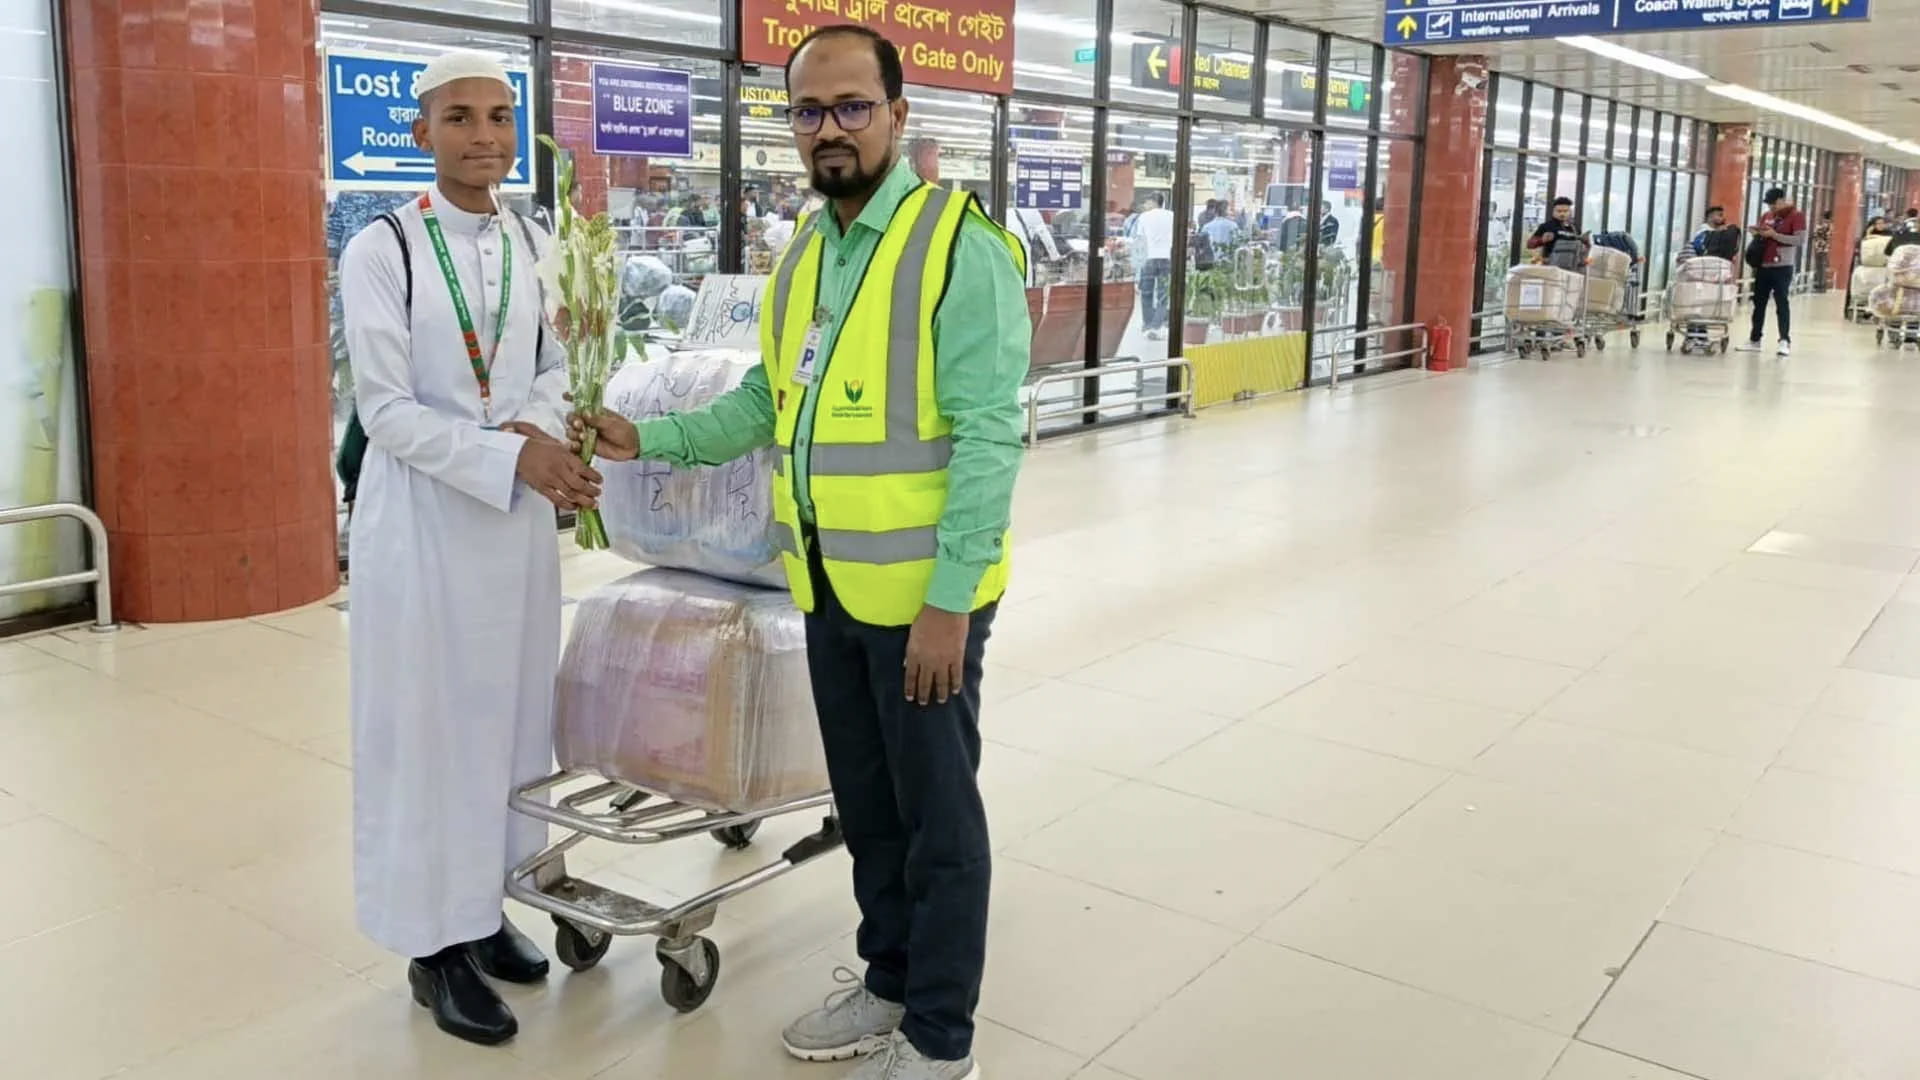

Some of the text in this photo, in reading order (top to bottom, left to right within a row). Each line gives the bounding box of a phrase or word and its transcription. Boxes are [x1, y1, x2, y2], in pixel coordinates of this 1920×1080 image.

[1461, 3, 1600, 23] International Arrivals
[1635, 0, 1678, 12] Coach
[895, 3, 951, 34] প্রবেশ
[958, 13, 1006, 44] গেইট
[912, 43, 957, 70] Gate
[963, 50, 1004, 81] Only
[335, 64, 401, 98] Lost
[613, 95, 675, 116] BLUE ZONE
[741, 86, 789, 104] USTOMS
[361, 127, 416, 149] Room
[801, 348, 815, 368] P
